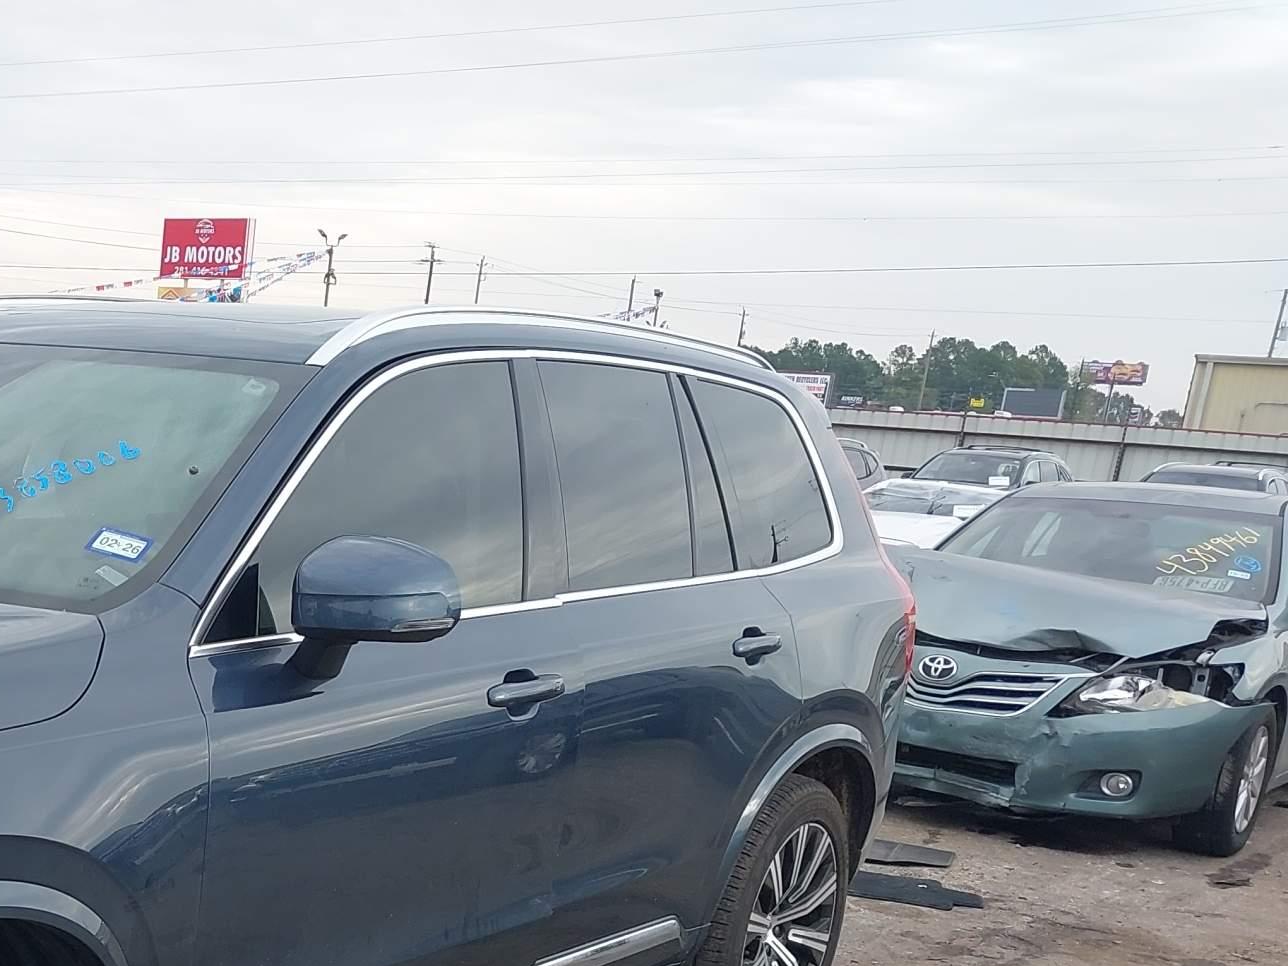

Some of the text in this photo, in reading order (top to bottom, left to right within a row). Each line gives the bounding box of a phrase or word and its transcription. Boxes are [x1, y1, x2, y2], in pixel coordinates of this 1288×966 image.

[164, 246, 242, 264] JB MOTORS
[1155, 526, 1261, 575] 43849461
